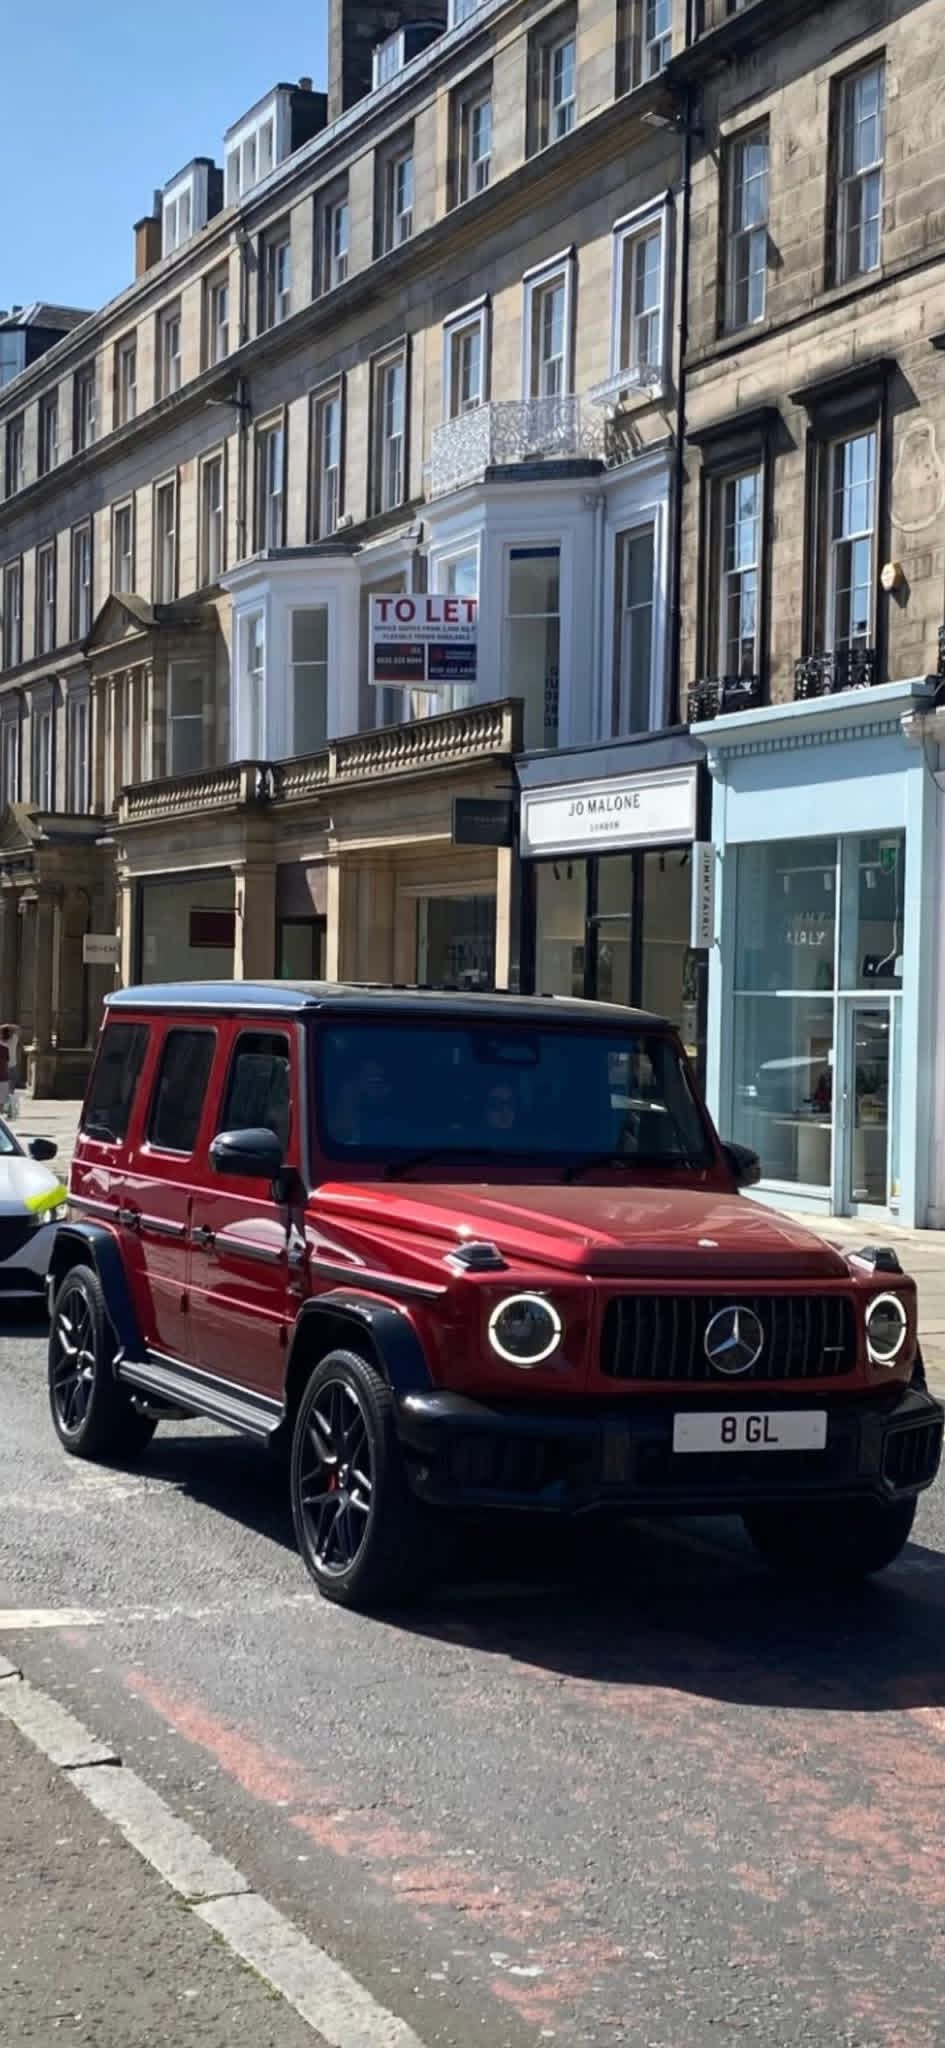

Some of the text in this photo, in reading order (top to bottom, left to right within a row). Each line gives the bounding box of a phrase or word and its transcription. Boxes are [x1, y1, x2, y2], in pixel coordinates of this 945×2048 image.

[376, 599, 477, 623] TO LET
[568, 793, 640, 816] JO MALONE
[721, 1415, 779, 1444] 8 GL
